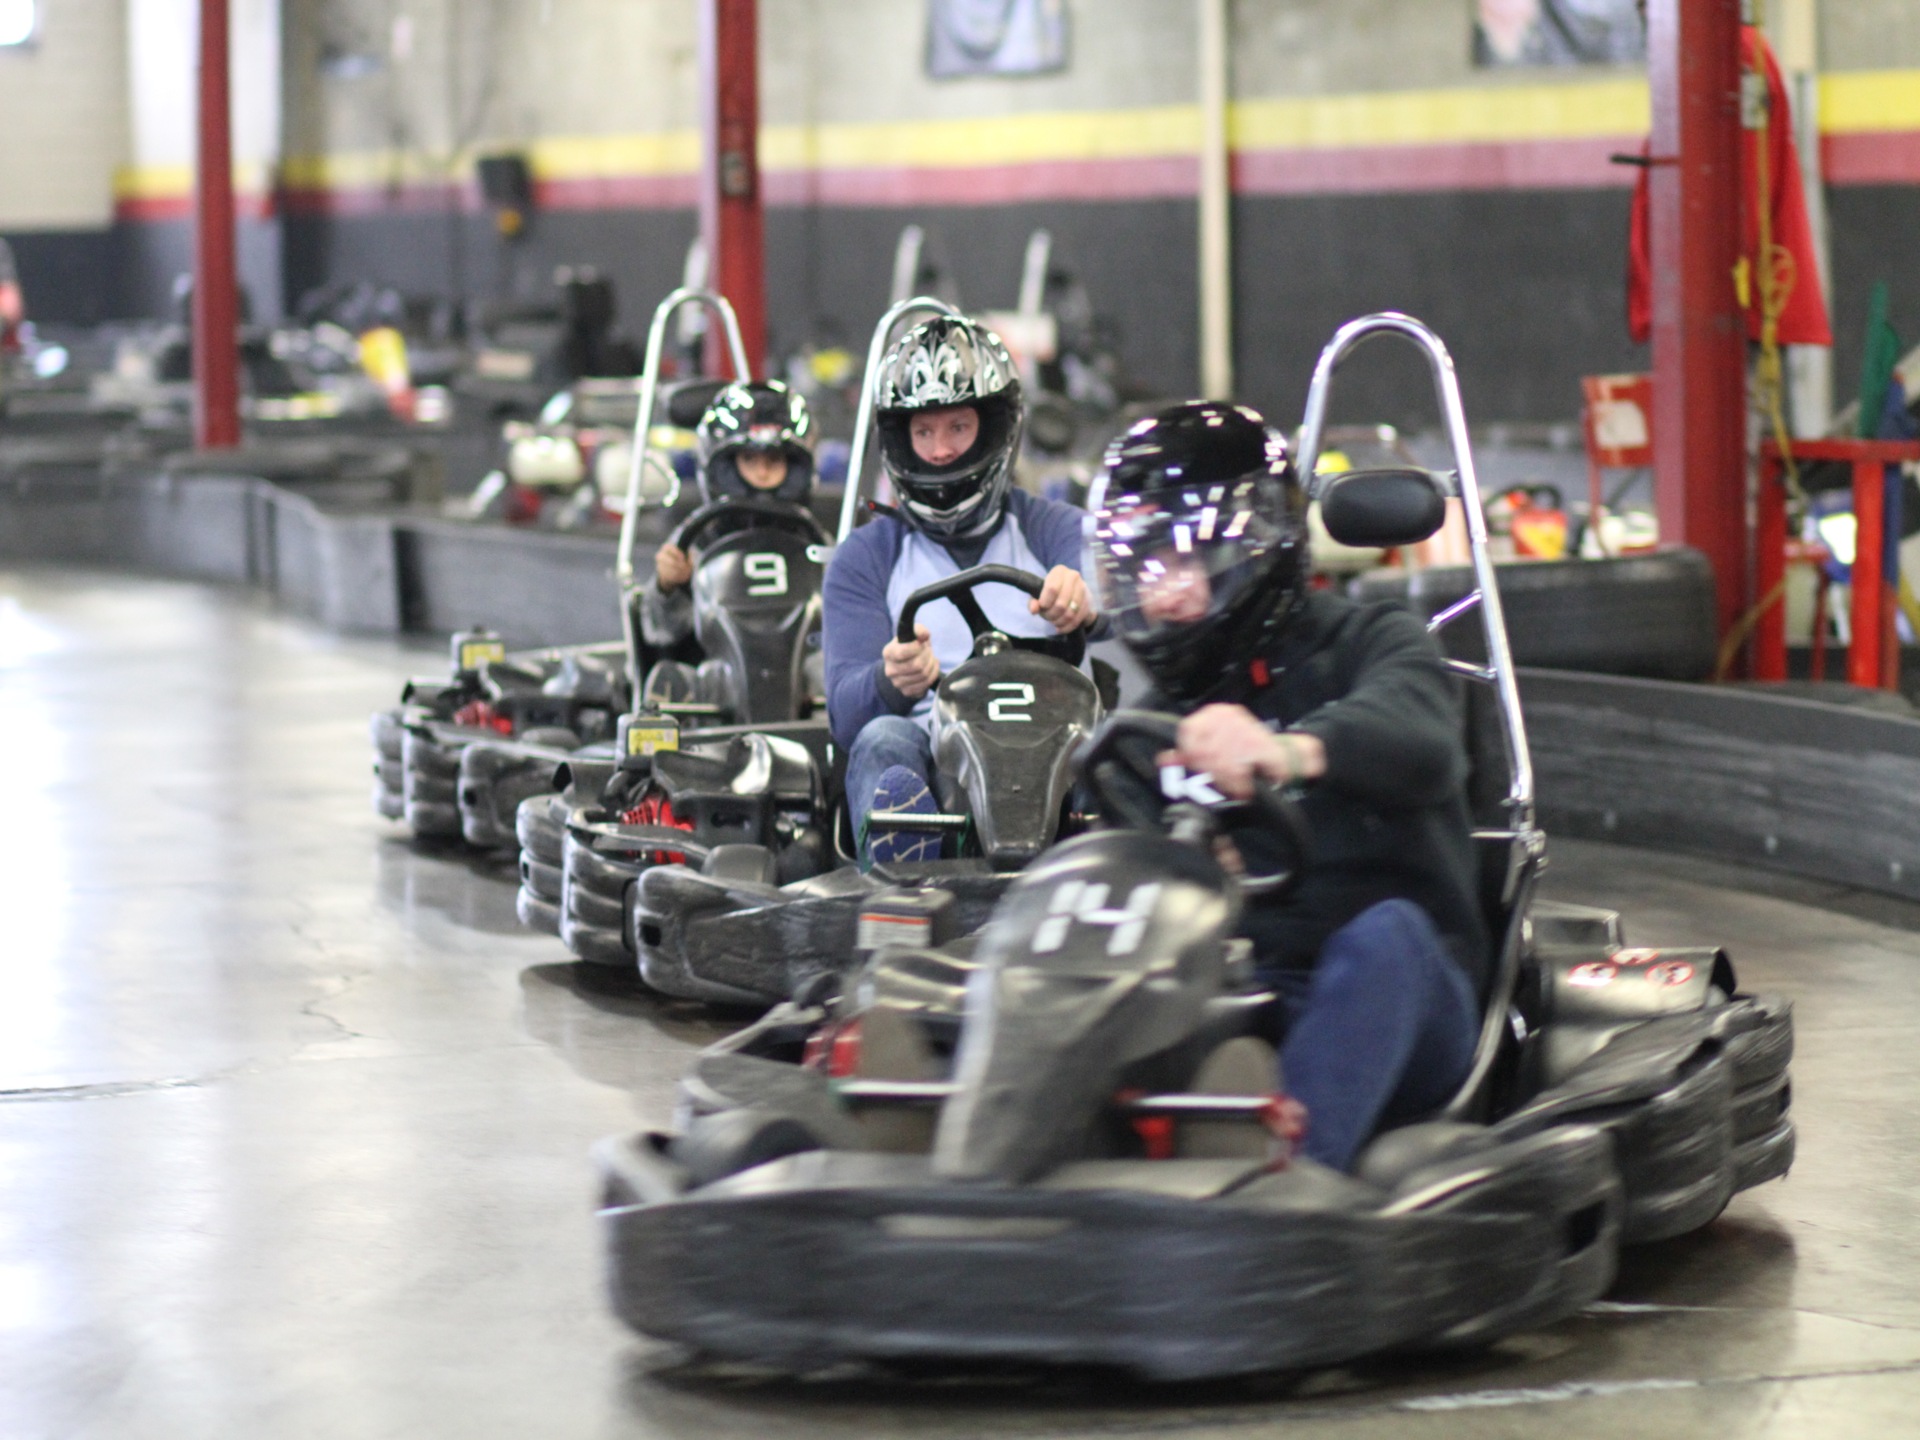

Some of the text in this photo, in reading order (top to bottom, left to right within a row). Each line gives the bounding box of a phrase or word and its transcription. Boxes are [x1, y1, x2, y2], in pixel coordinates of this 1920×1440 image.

[744, 552, 788, 596] 9
[987, 682, 1036, 722] 2
[1031, 880, 1162, 956] 14
